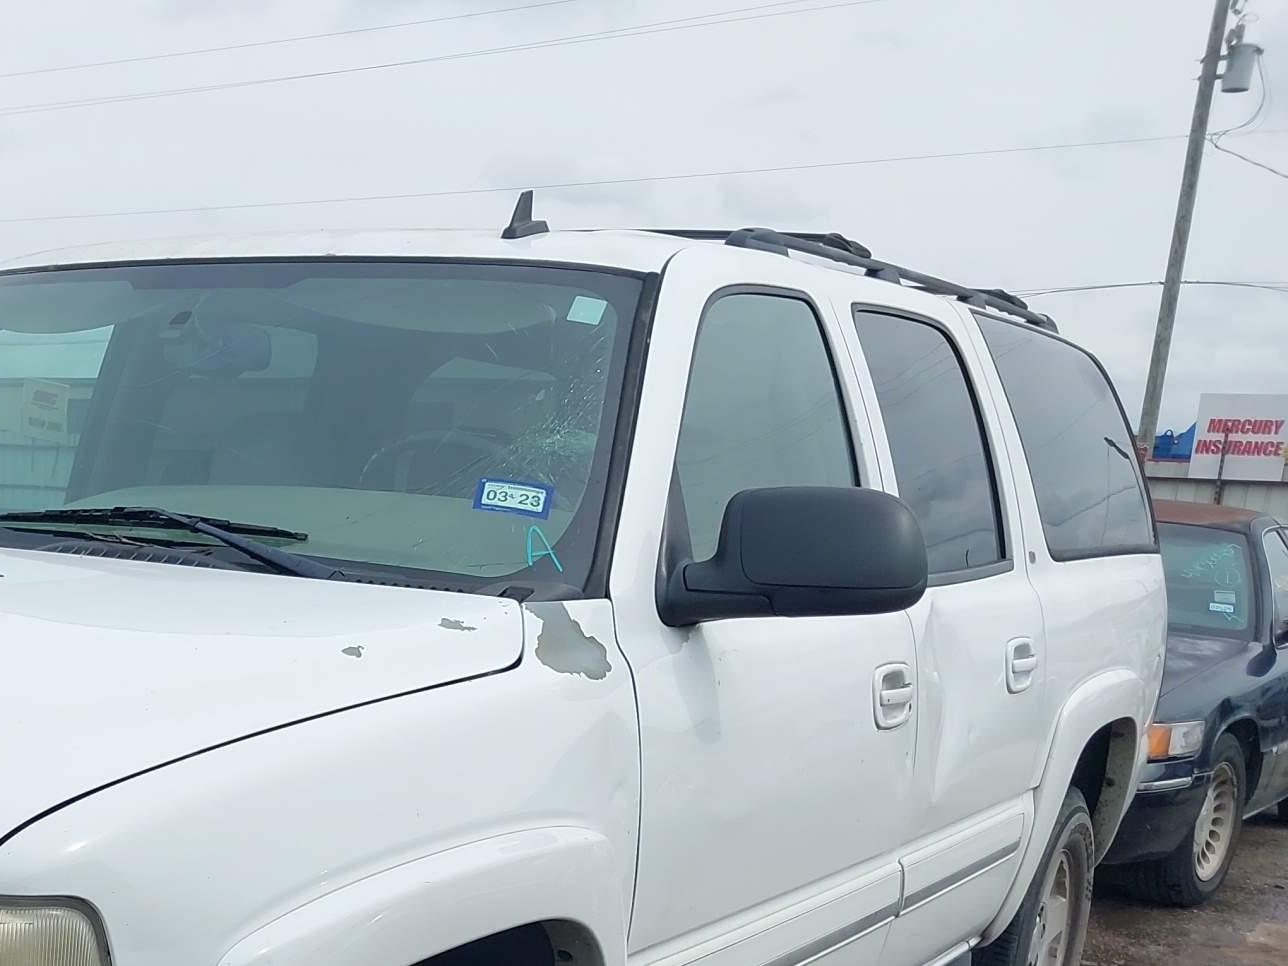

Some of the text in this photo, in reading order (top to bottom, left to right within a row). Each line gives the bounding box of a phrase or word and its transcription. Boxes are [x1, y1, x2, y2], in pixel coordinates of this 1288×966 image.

[1207, 418, 1285, 435] MERCURY
[1195, 439, 1284, 457] INSURANCE
[486, 489, 541, 508] 03 23
[527, 525, 564, 572] A
